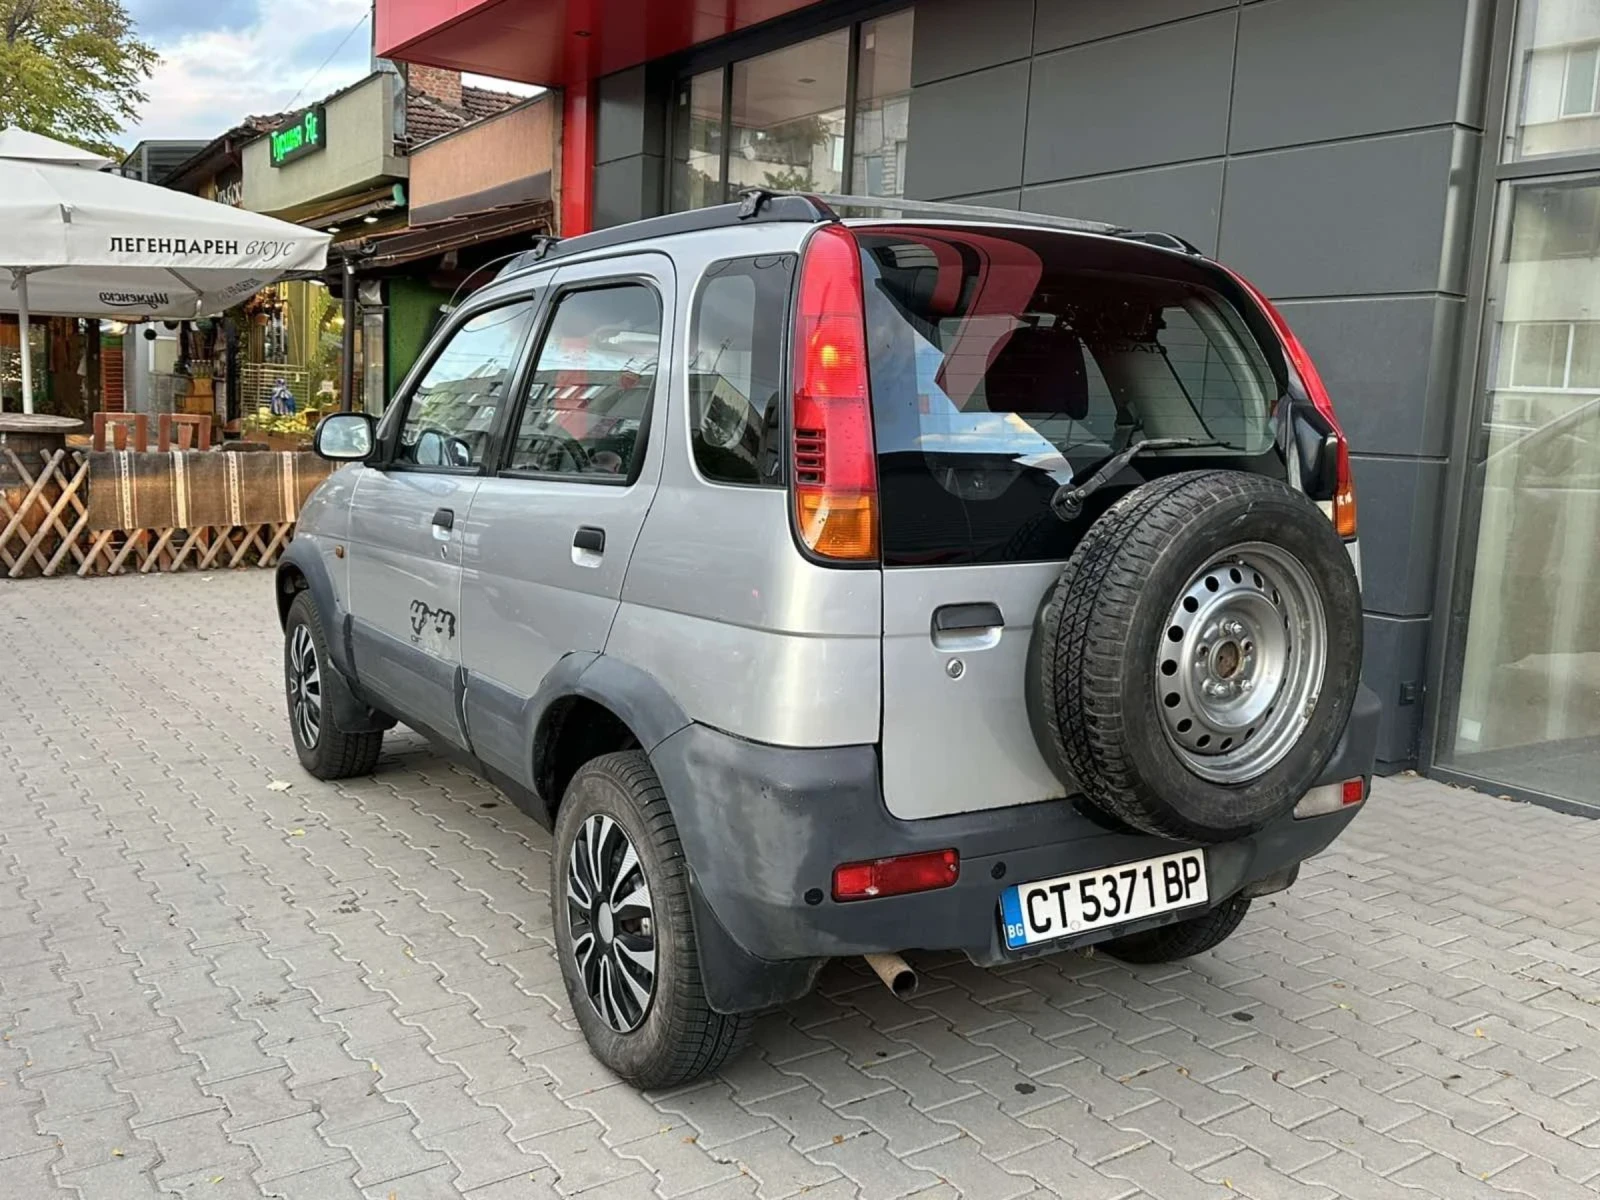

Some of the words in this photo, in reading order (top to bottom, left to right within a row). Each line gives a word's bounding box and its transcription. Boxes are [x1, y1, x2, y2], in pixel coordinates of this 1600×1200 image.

[109, 237, 238, 256] ЛЕГЕНДАРЕН
[245, 239, 296, 261] вкус
[1026, 882, 1071, 934] CT
[1079, 866, 1156, 922] 5371
[1162, 856, 1201, 903] BP
[1007, 924, 1024, 939] BG
